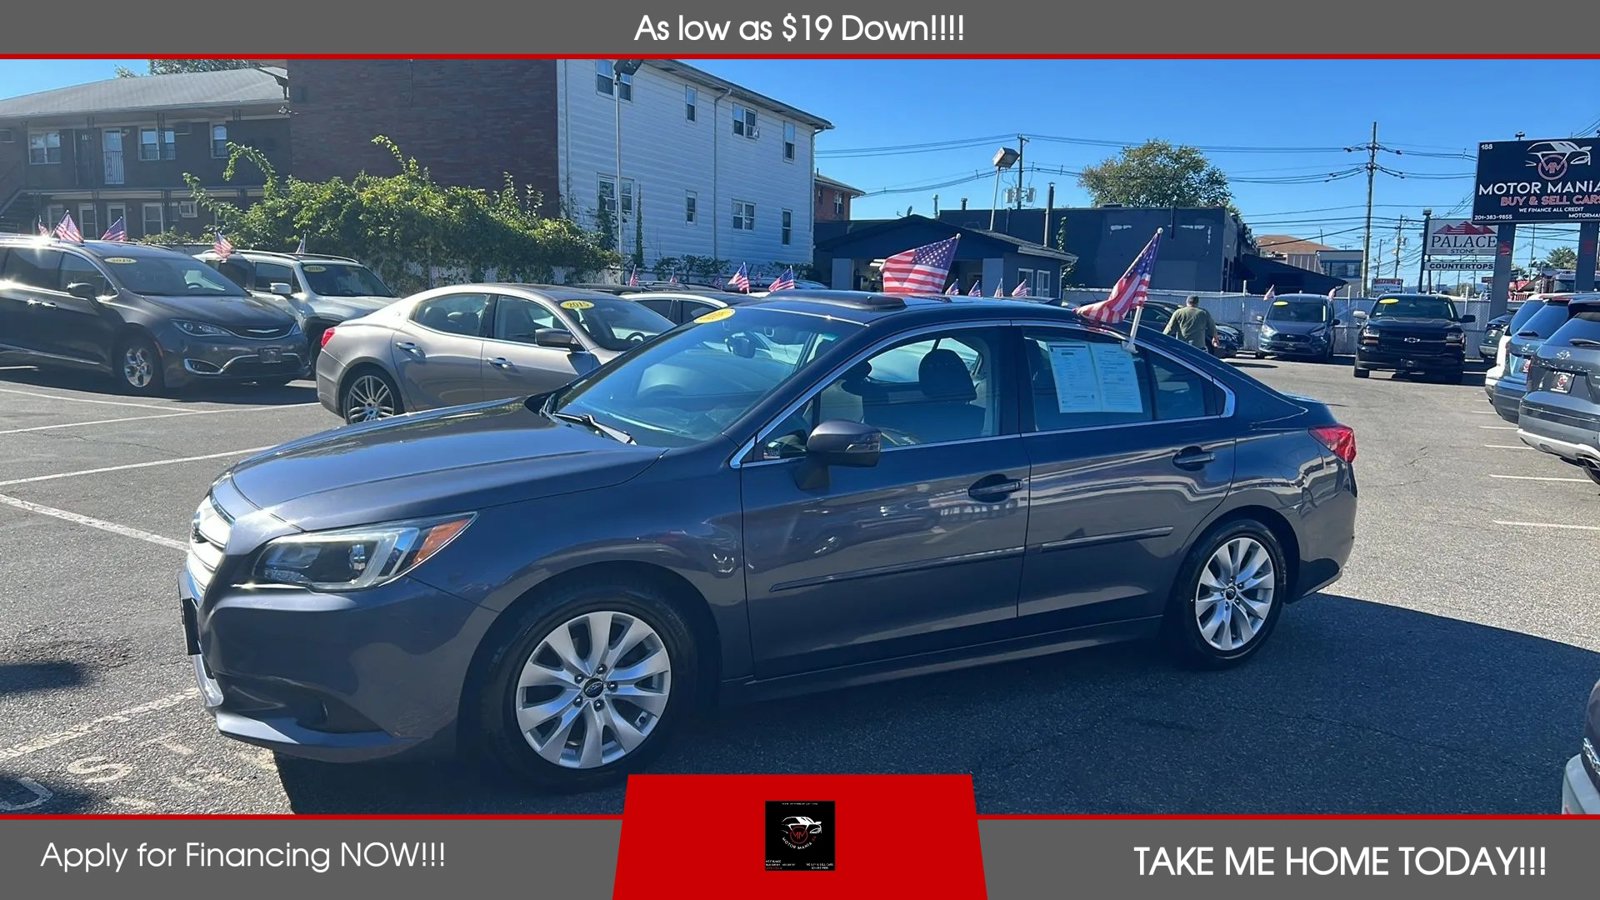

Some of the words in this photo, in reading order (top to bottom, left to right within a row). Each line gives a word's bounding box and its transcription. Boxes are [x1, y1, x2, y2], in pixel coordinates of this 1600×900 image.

[1478, 181, 1542, 196] MOTOR
[1500, 196, 1528, 207] BUY
[1529, 196, 1538, 206] &
[1541, 195, 1570, 205] SELL
[1431, 235, 1498, 248] PALACE
[1429, 262, 1494, 270] COUNTERTOPS
